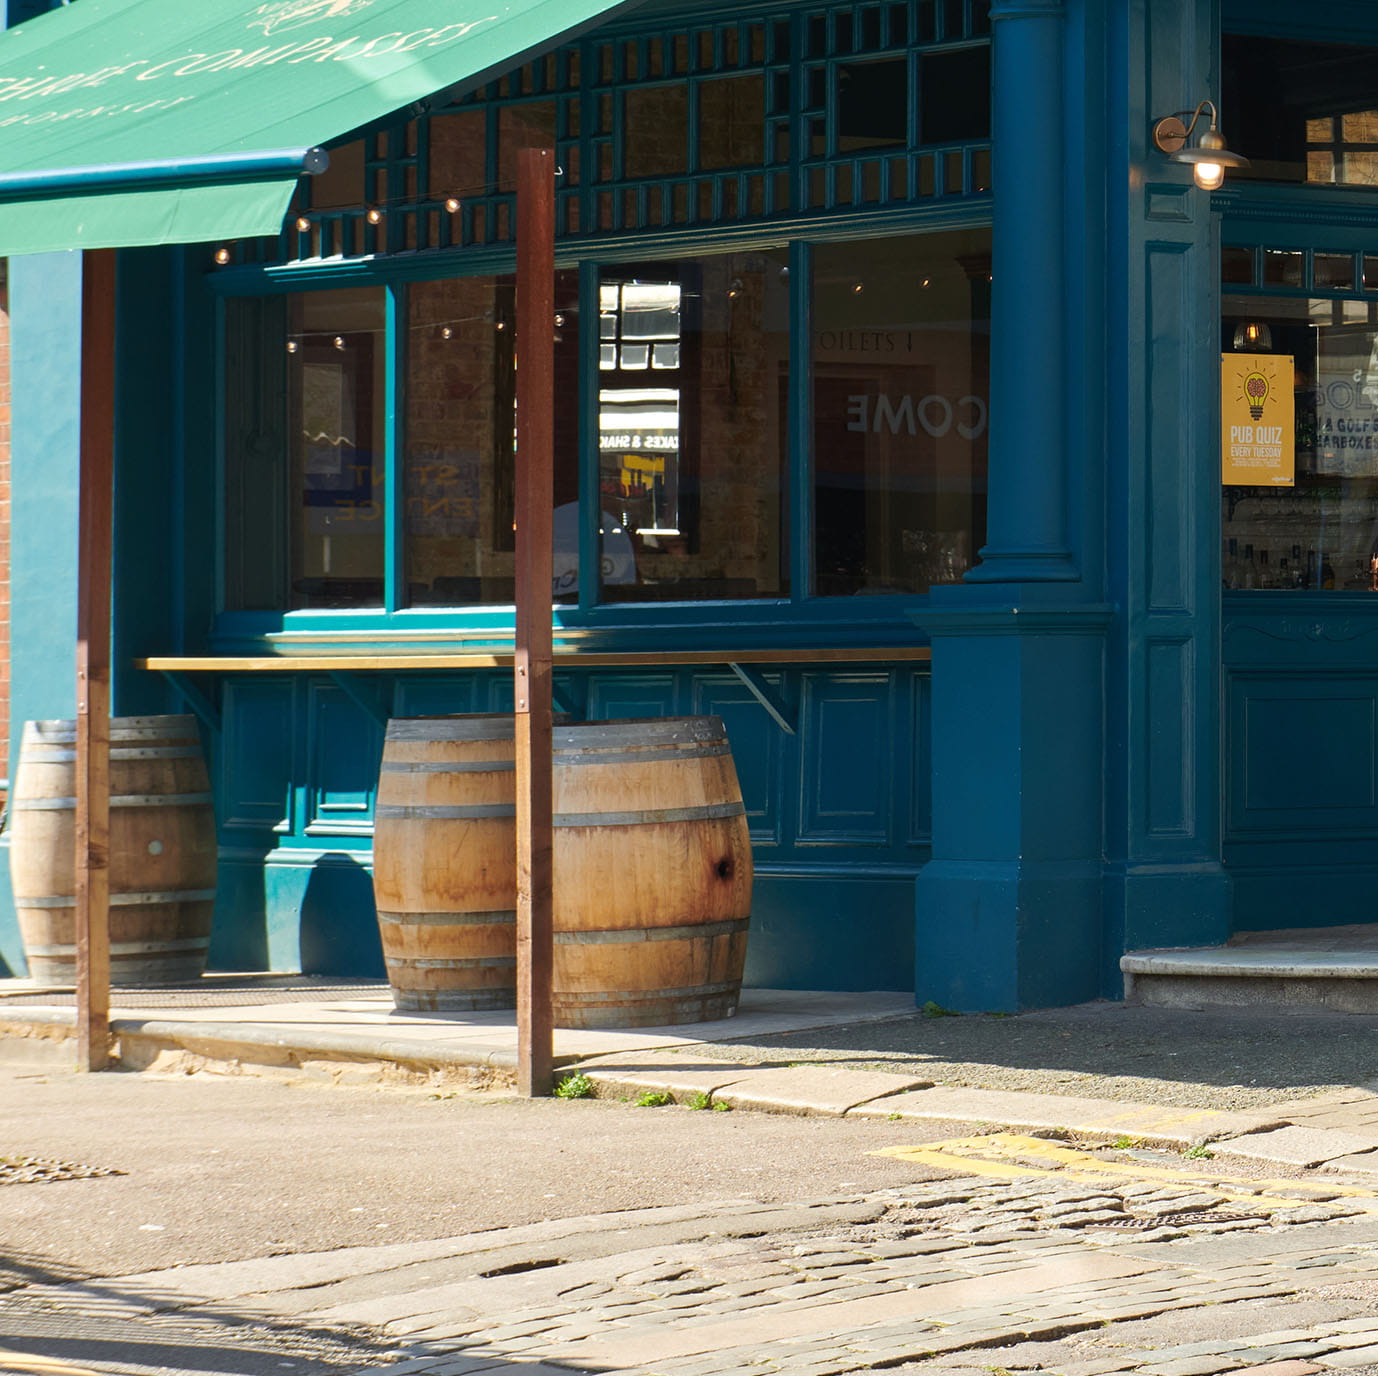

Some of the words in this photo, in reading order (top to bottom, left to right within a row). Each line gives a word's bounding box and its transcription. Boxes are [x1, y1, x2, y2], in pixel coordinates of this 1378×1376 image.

[136, 16, 496, 82] COMPASSES
[815, 329, 896, 352] OILETS
[1231, 425, 1253, 444] PUB
[1256, 426, 1283, 445] QUIZ
[1231, 446, 1251, 457] EVERY
[1253, 447, 1282, 457] TUESDAY
